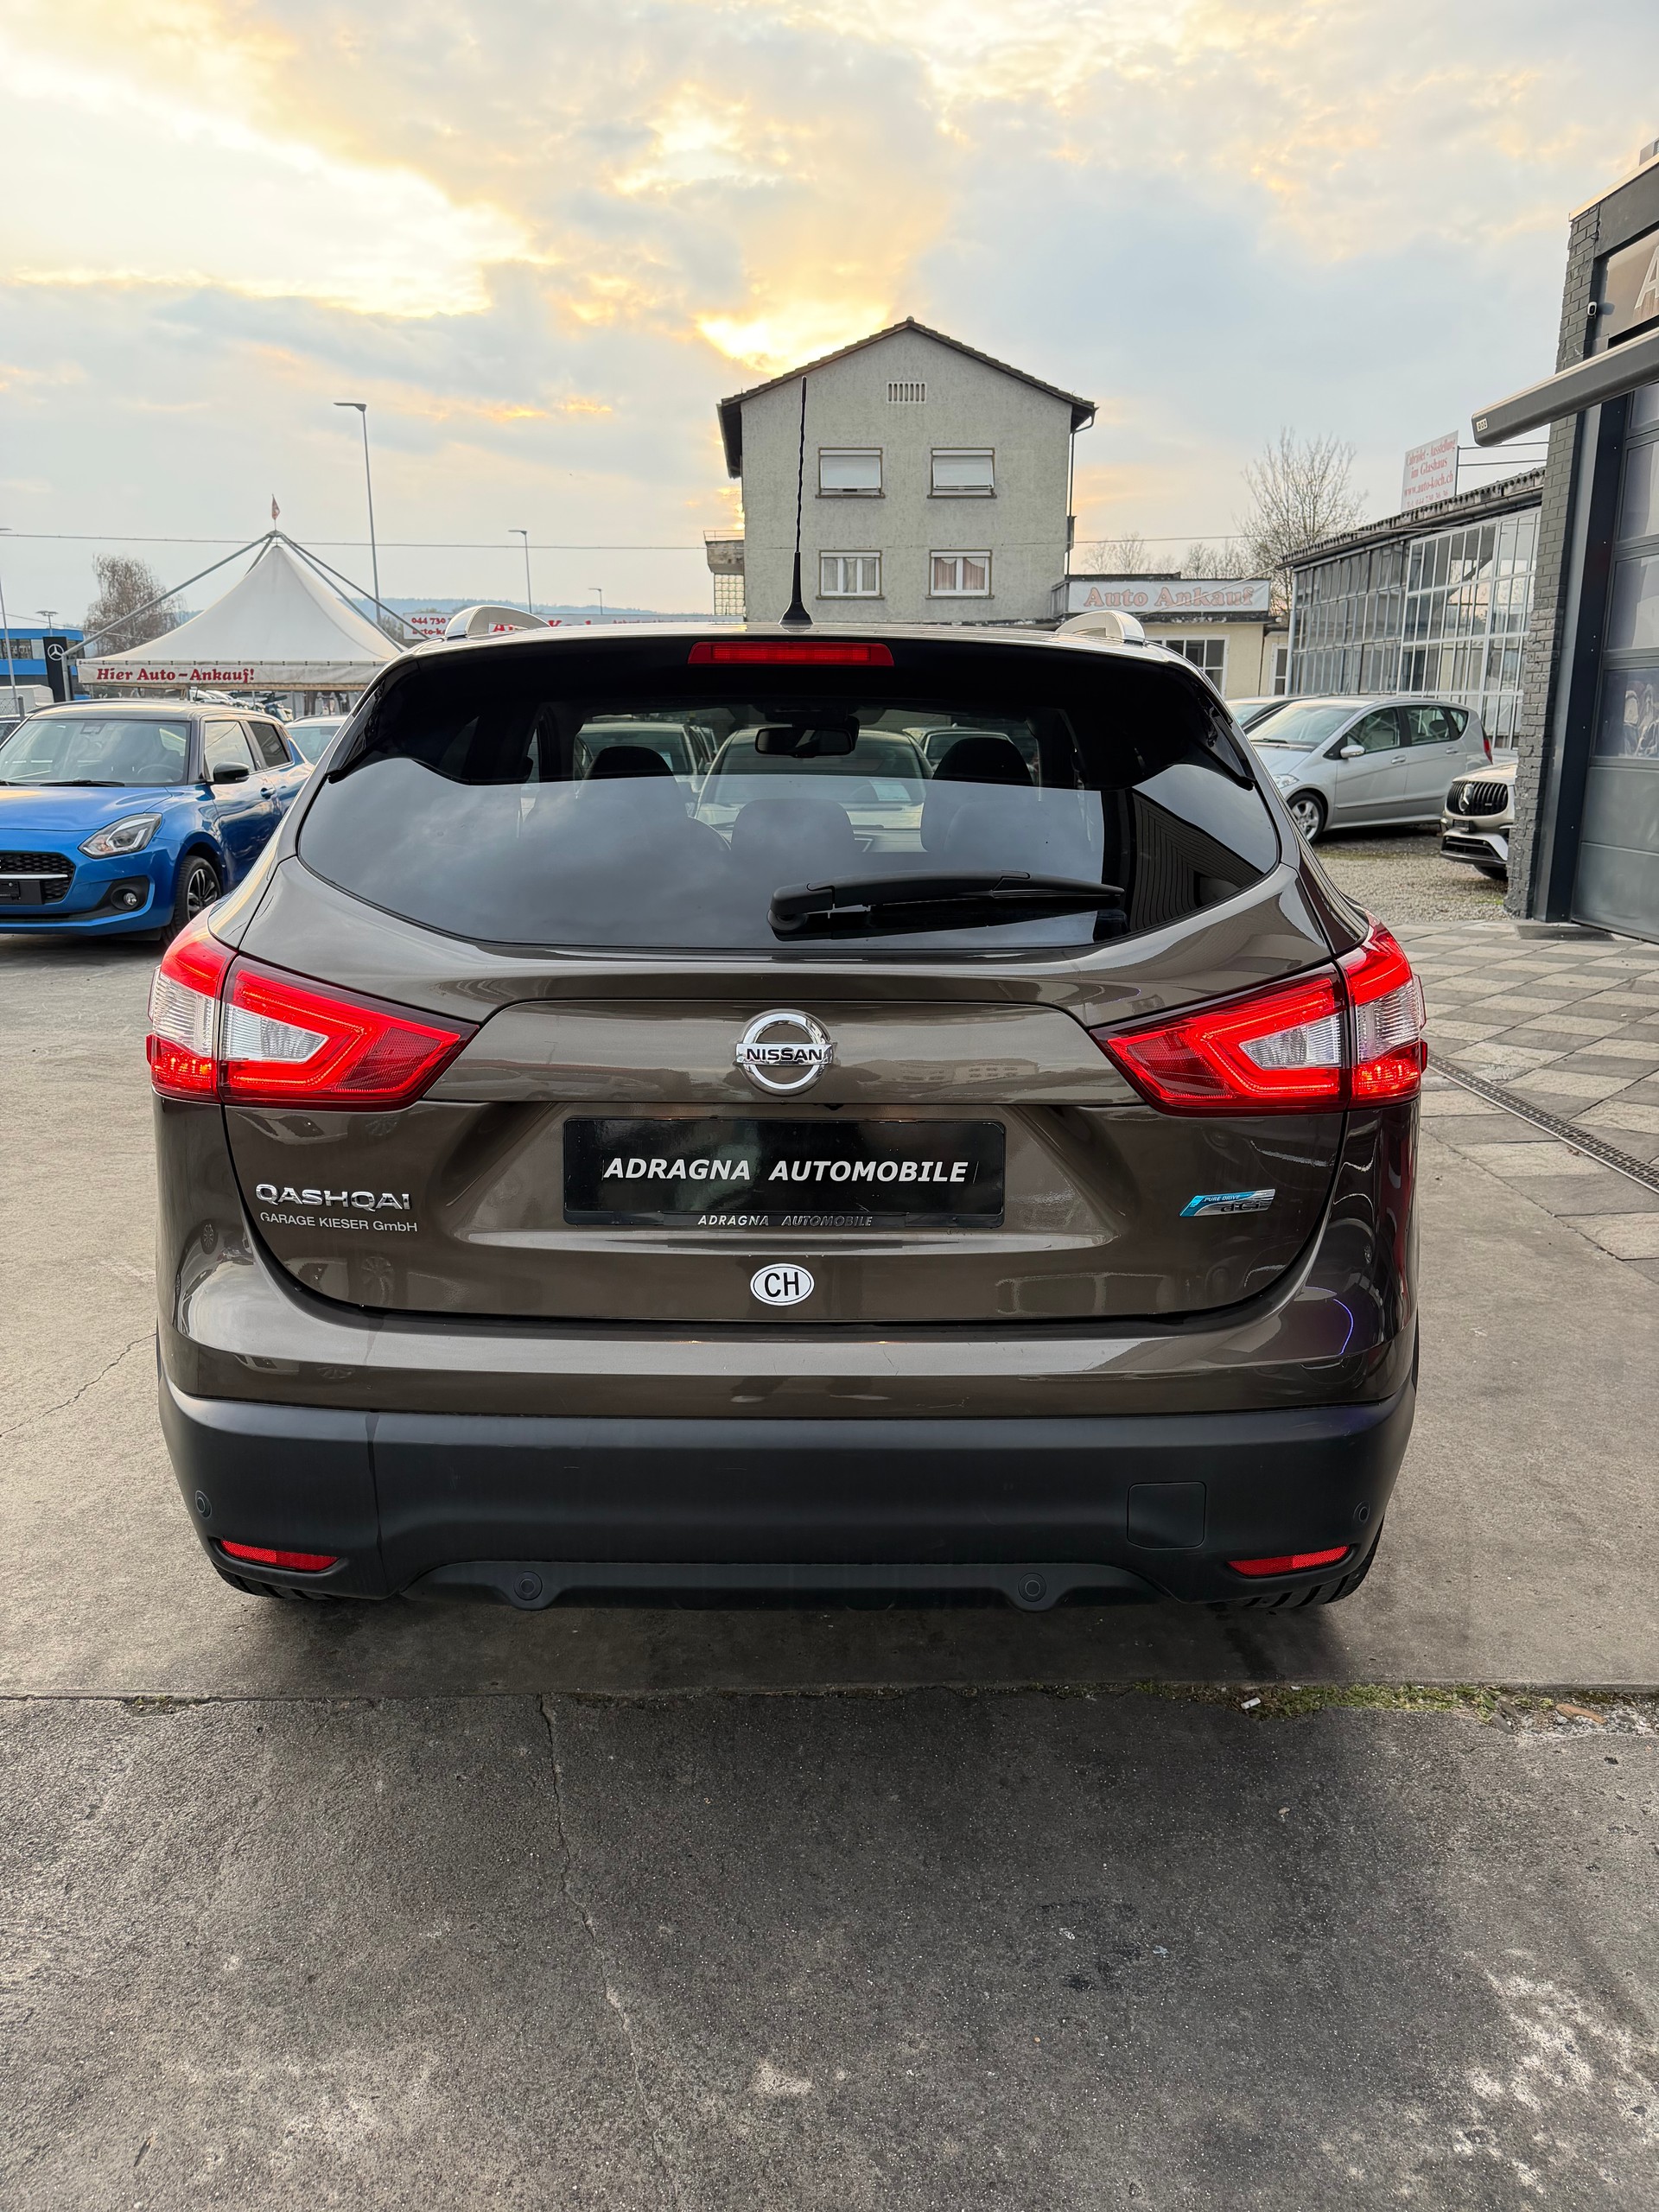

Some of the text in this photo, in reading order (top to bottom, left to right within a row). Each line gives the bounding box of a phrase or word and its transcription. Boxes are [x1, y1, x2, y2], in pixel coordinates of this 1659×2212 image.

[1421, 458, 1447, 475] Glashaus
[1084, 587, 1255, 607] Auto Ankauf
[97, 668, 133, 680] Hier
[747, 1047, 822, 1061] NISSAN
[603, 1158, 969, 1183] ADRAGNA AUTOMOBILE
[256, 1183, 413, 1212] QASHQAI
[260, 1211, 418, 1232] GARAGE KIESER GmbH
[697, 1215, 873, 1227] ADRAGNA AUTOMOBILE
[765, 1272, 799, 1297] CH
